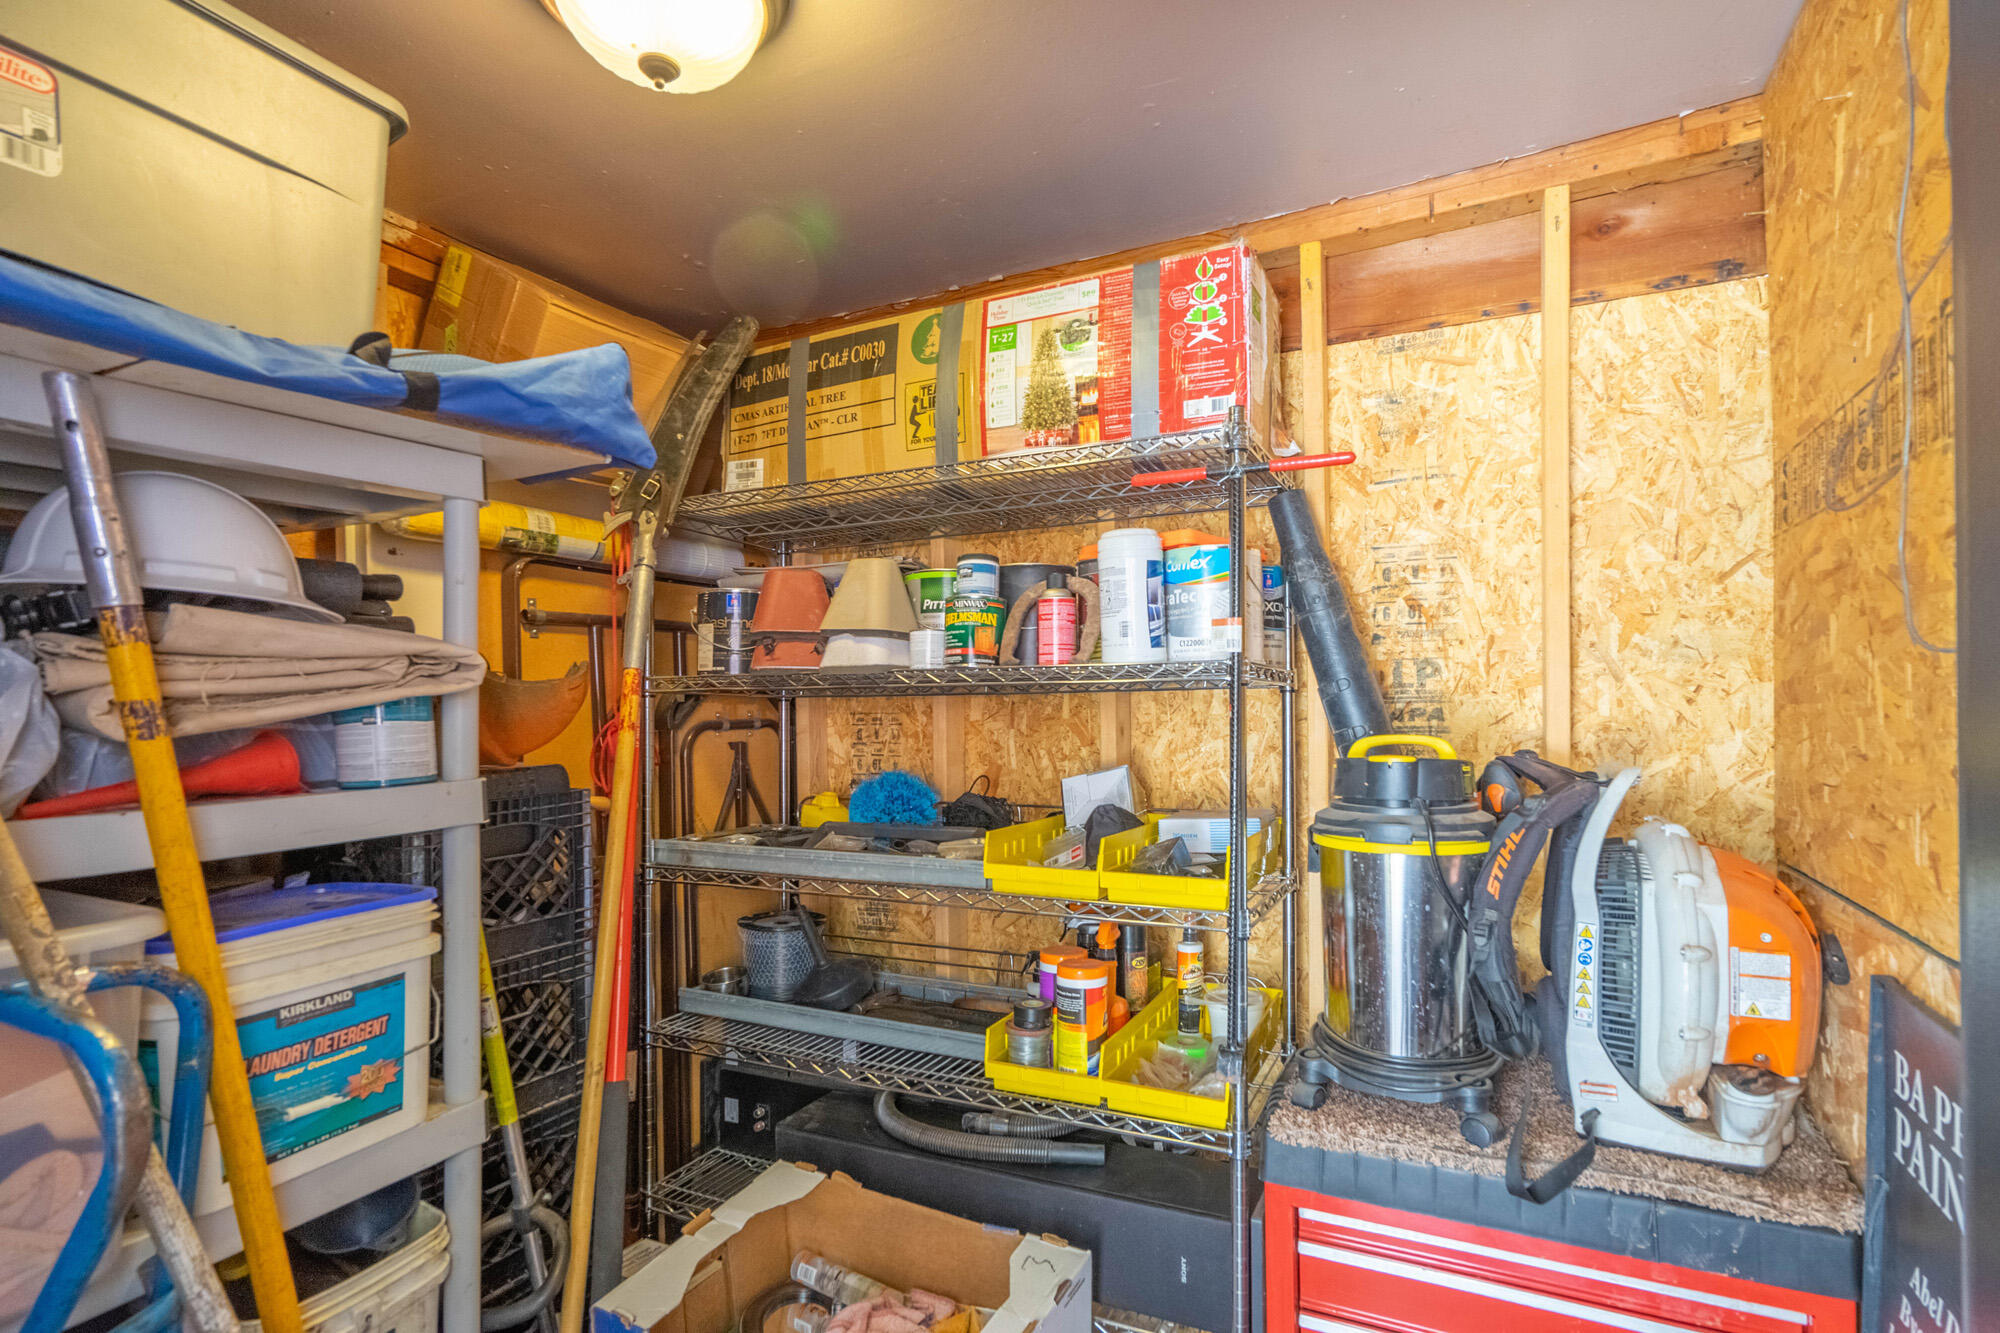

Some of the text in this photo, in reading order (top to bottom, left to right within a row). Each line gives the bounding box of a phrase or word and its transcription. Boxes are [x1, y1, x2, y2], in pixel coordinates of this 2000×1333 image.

[992, 332, 1014, 344] T-27
[735, 369, 760, 392] Dept.
[820, 347, 848, 371] Cat.#
[851, 340, 886, 363] C0030
[734, 409, 760, 424] CMAS
[819, 390, 847, 406] TREE
[733, 431, 758, 447] (T-27)
[836, 411, 858, 426] CLR
[945, 612, 997, 626] HELMSMAN
[954, 600, 986, 608] MINWAX
[1486, 828, 1526, 900] STIHL
[279, 990, 353, 1020] KIRKLAND
[313, 1015, 390, 1054] DETERGENT
[1893, 1049, 1929, 1124] BA
[1908, 1266, 1942, 1327] Abel
